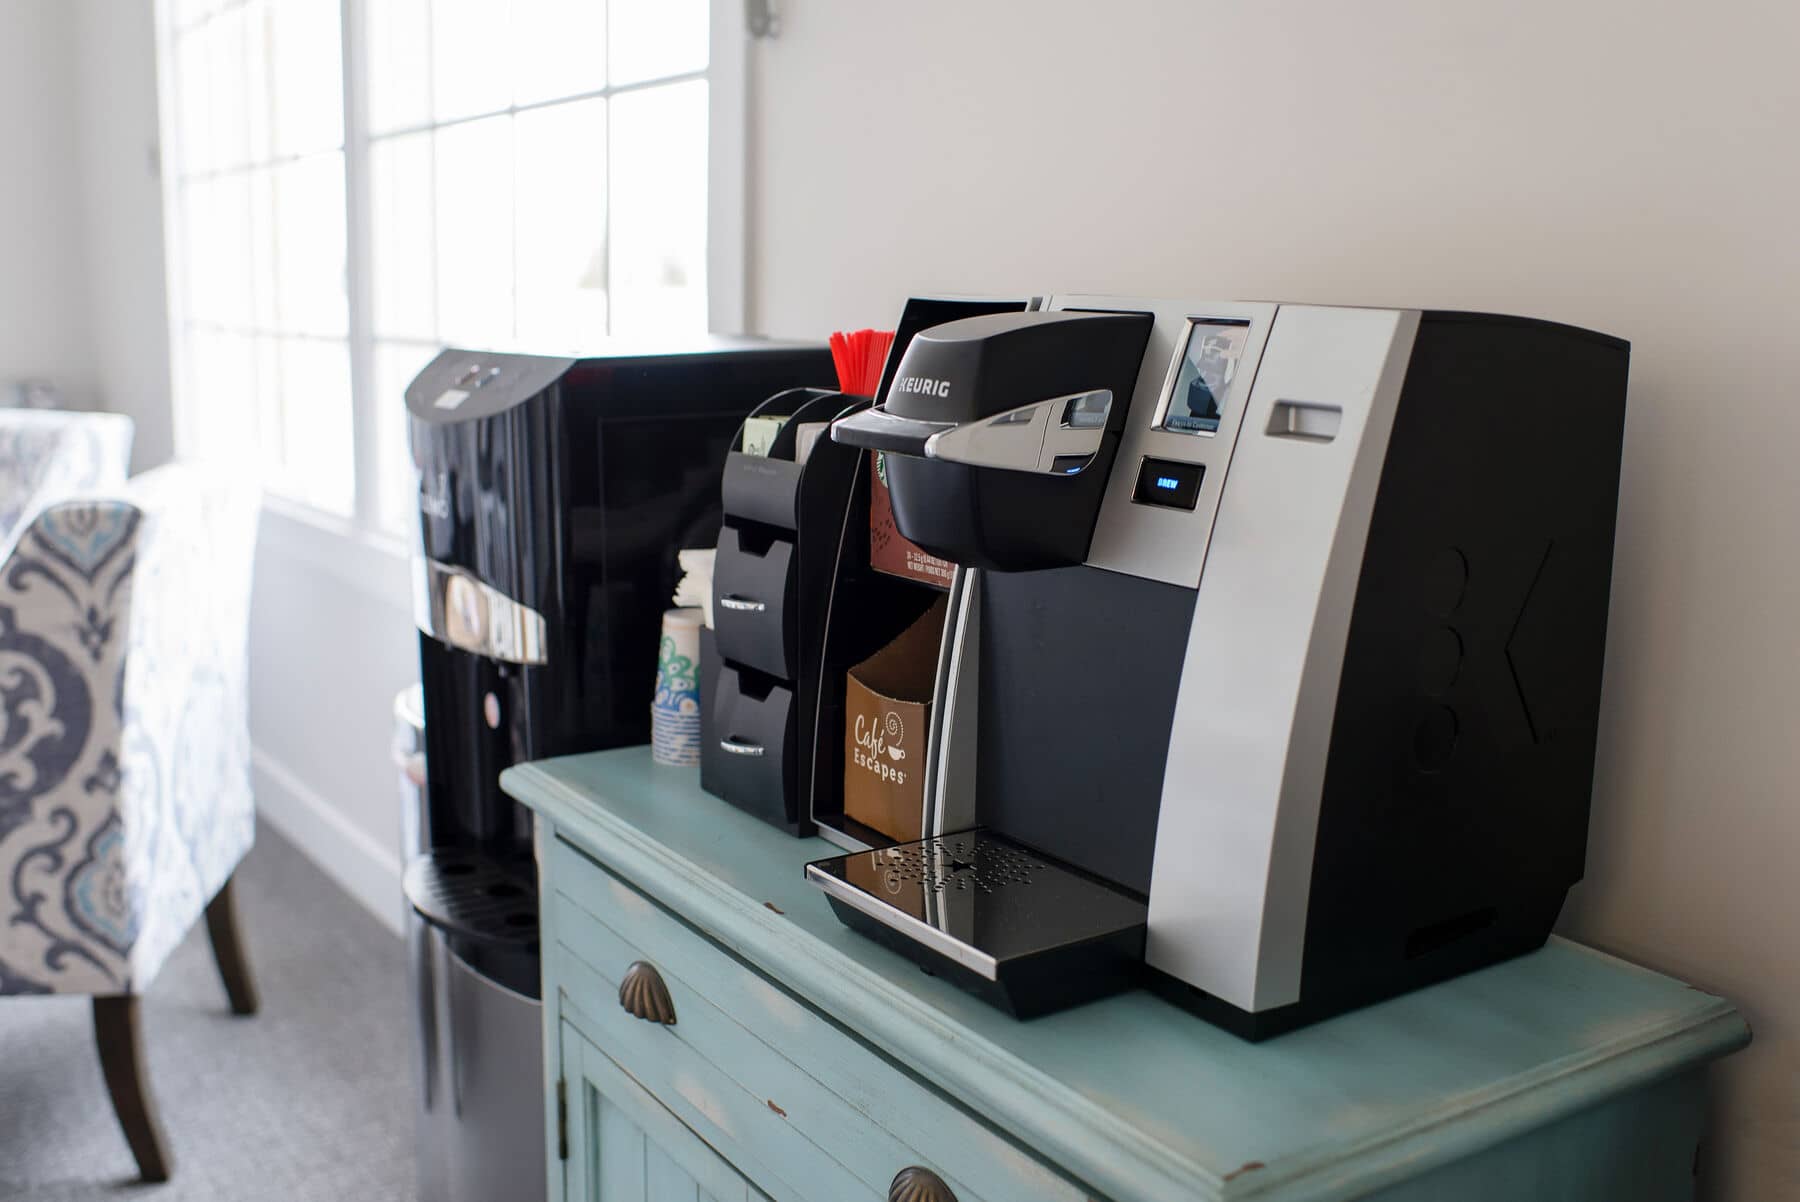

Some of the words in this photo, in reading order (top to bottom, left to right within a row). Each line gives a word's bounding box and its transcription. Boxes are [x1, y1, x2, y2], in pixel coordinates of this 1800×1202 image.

[899, 377, 950, 397] KEURIG
[1157, 477, 1178, 489] BREW
[855, 714, 886, 760] Café
[854, 747, 904, 784] Escapes
